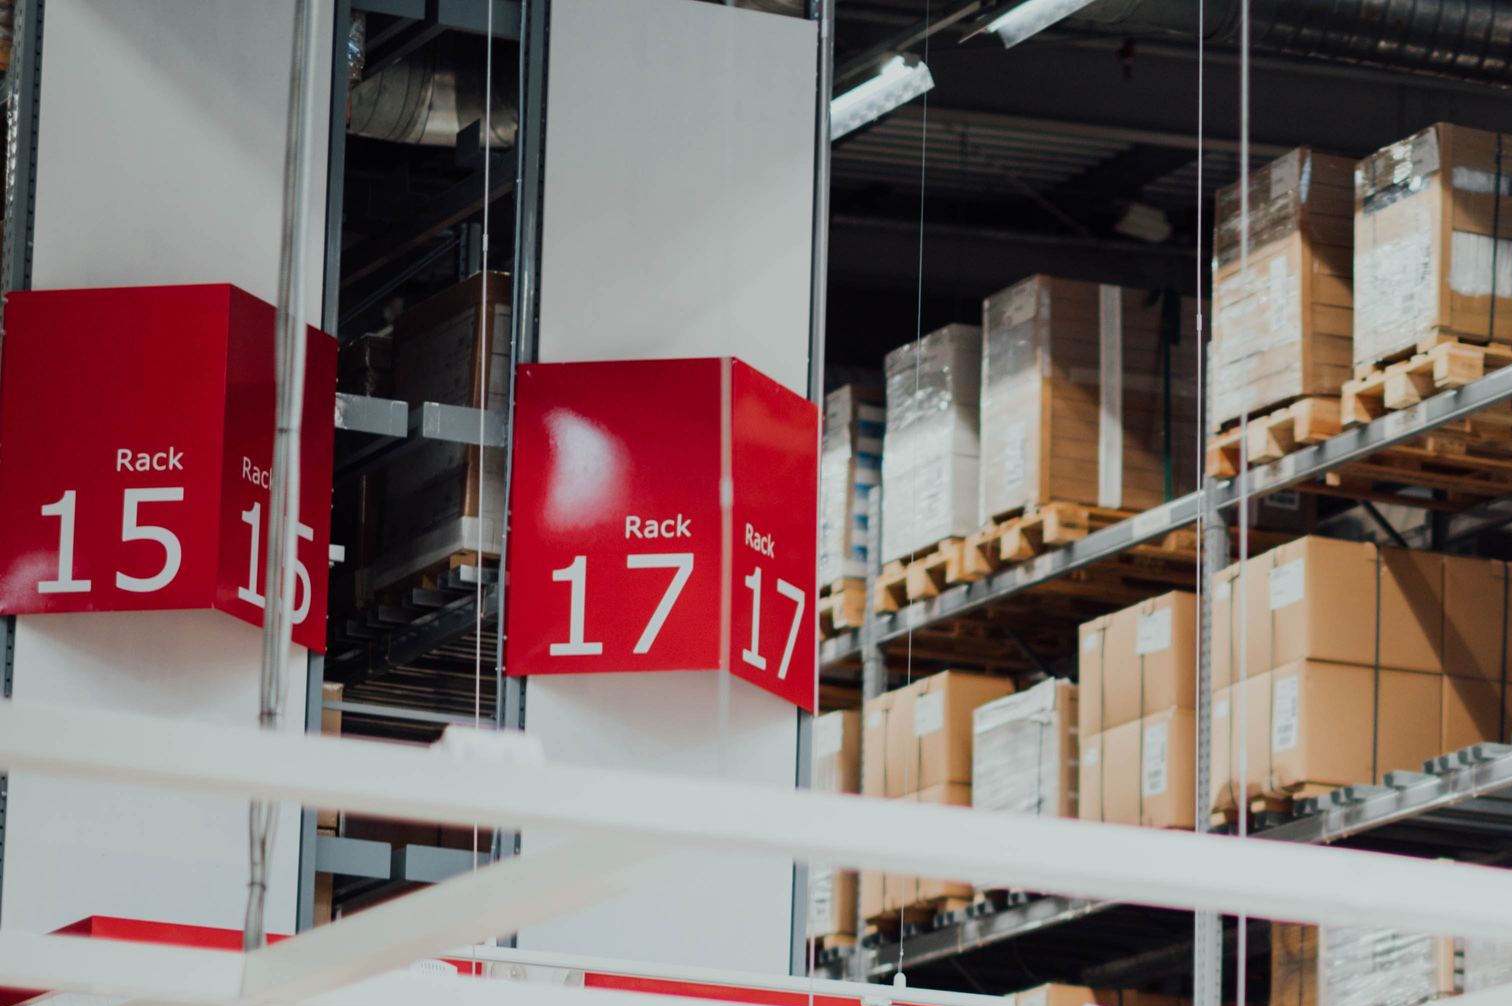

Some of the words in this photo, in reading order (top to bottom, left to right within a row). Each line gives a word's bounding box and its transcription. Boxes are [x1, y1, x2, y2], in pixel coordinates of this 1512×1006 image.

[116, 447, 184, 472] Rack
[242, 456, 273, 490] Rac
[38, 487, 185, 593] 15
[625, 513, 692, 539] Rack
[745, 523, 775, 559] Rack
[549, 552, 694, 656] 17
[742, 566, 805, 680] 17
